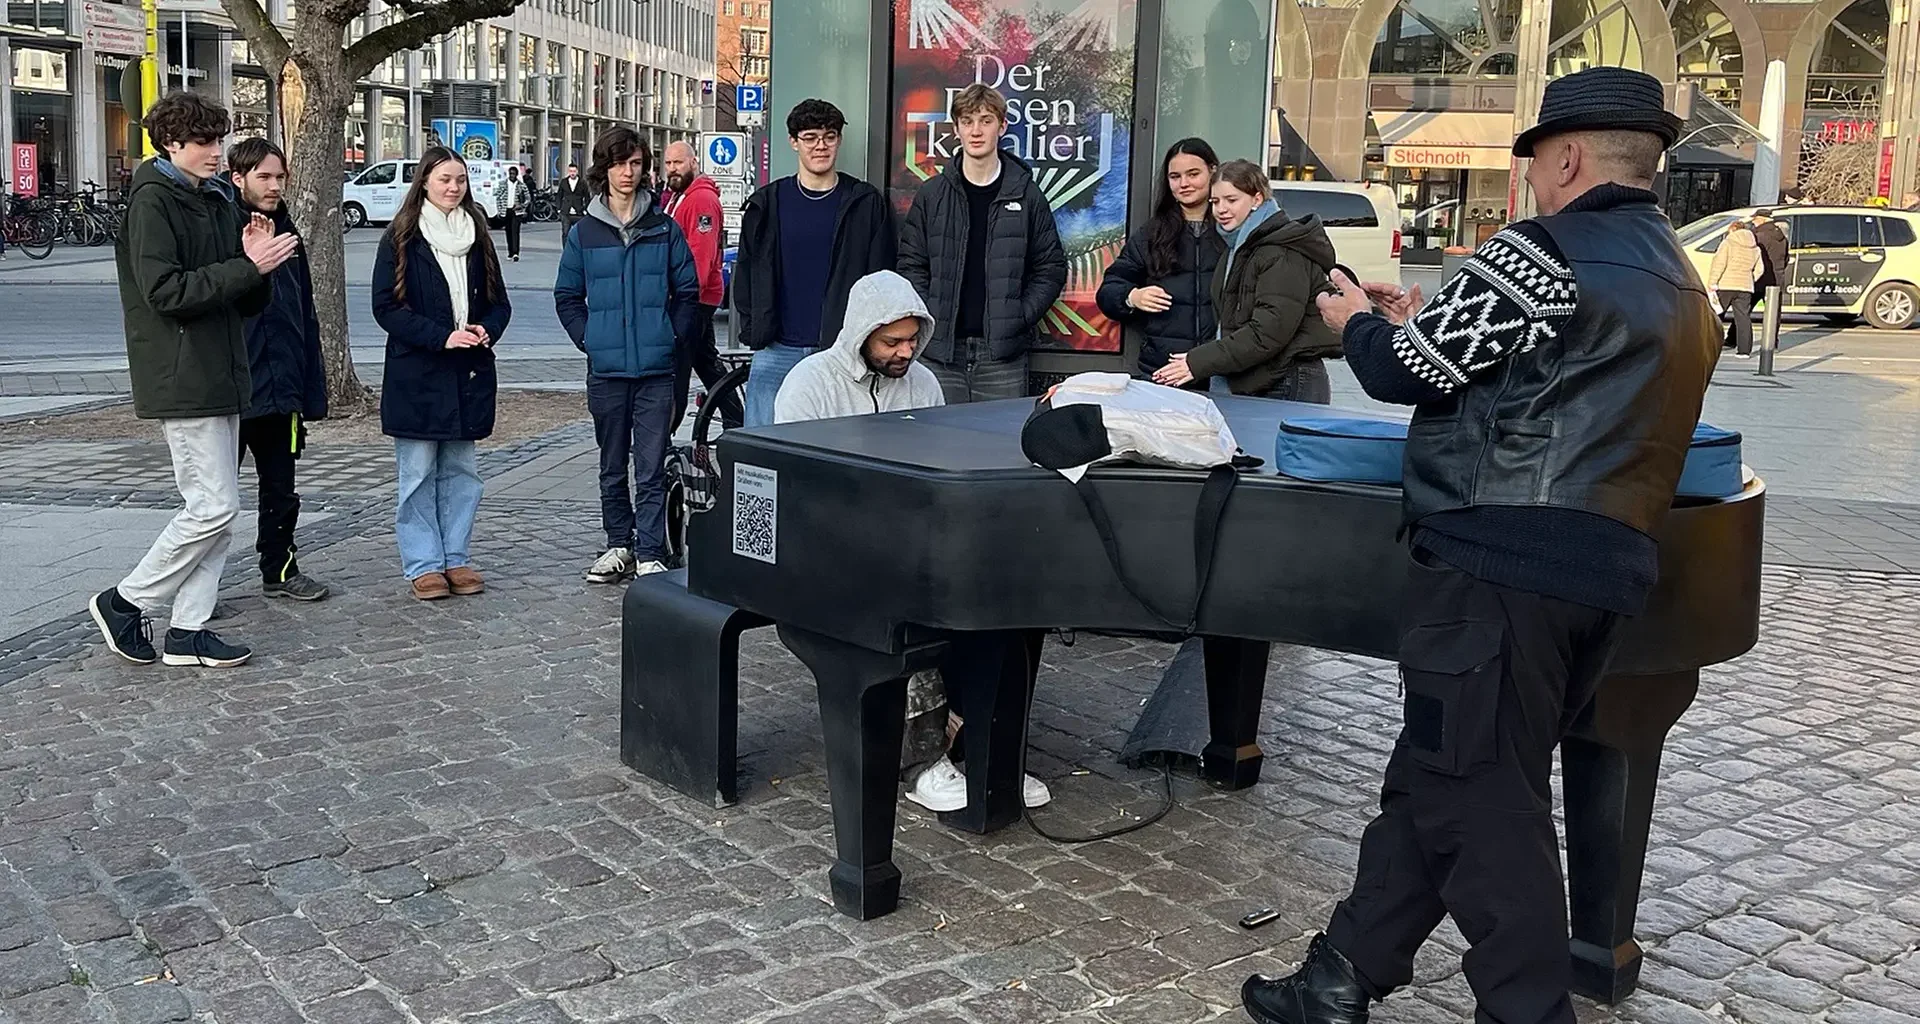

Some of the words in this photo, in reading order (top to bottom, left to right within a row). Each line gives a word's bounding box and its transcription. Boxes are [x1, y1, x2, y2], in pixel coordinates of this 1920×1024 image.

[974, 54, 1051, 92] Der
[743, 89, 757, 109] P
[944, 87, 1076, 127] sen
[927, 121, 1093, 161] kaalier
[1394, 149, 1471, 165] Stichnoth
[712, 167, 734, 175] ZONE
[1824, 285, 1831, 293] &
[1832, 284, 1863, 294] Jacobi
